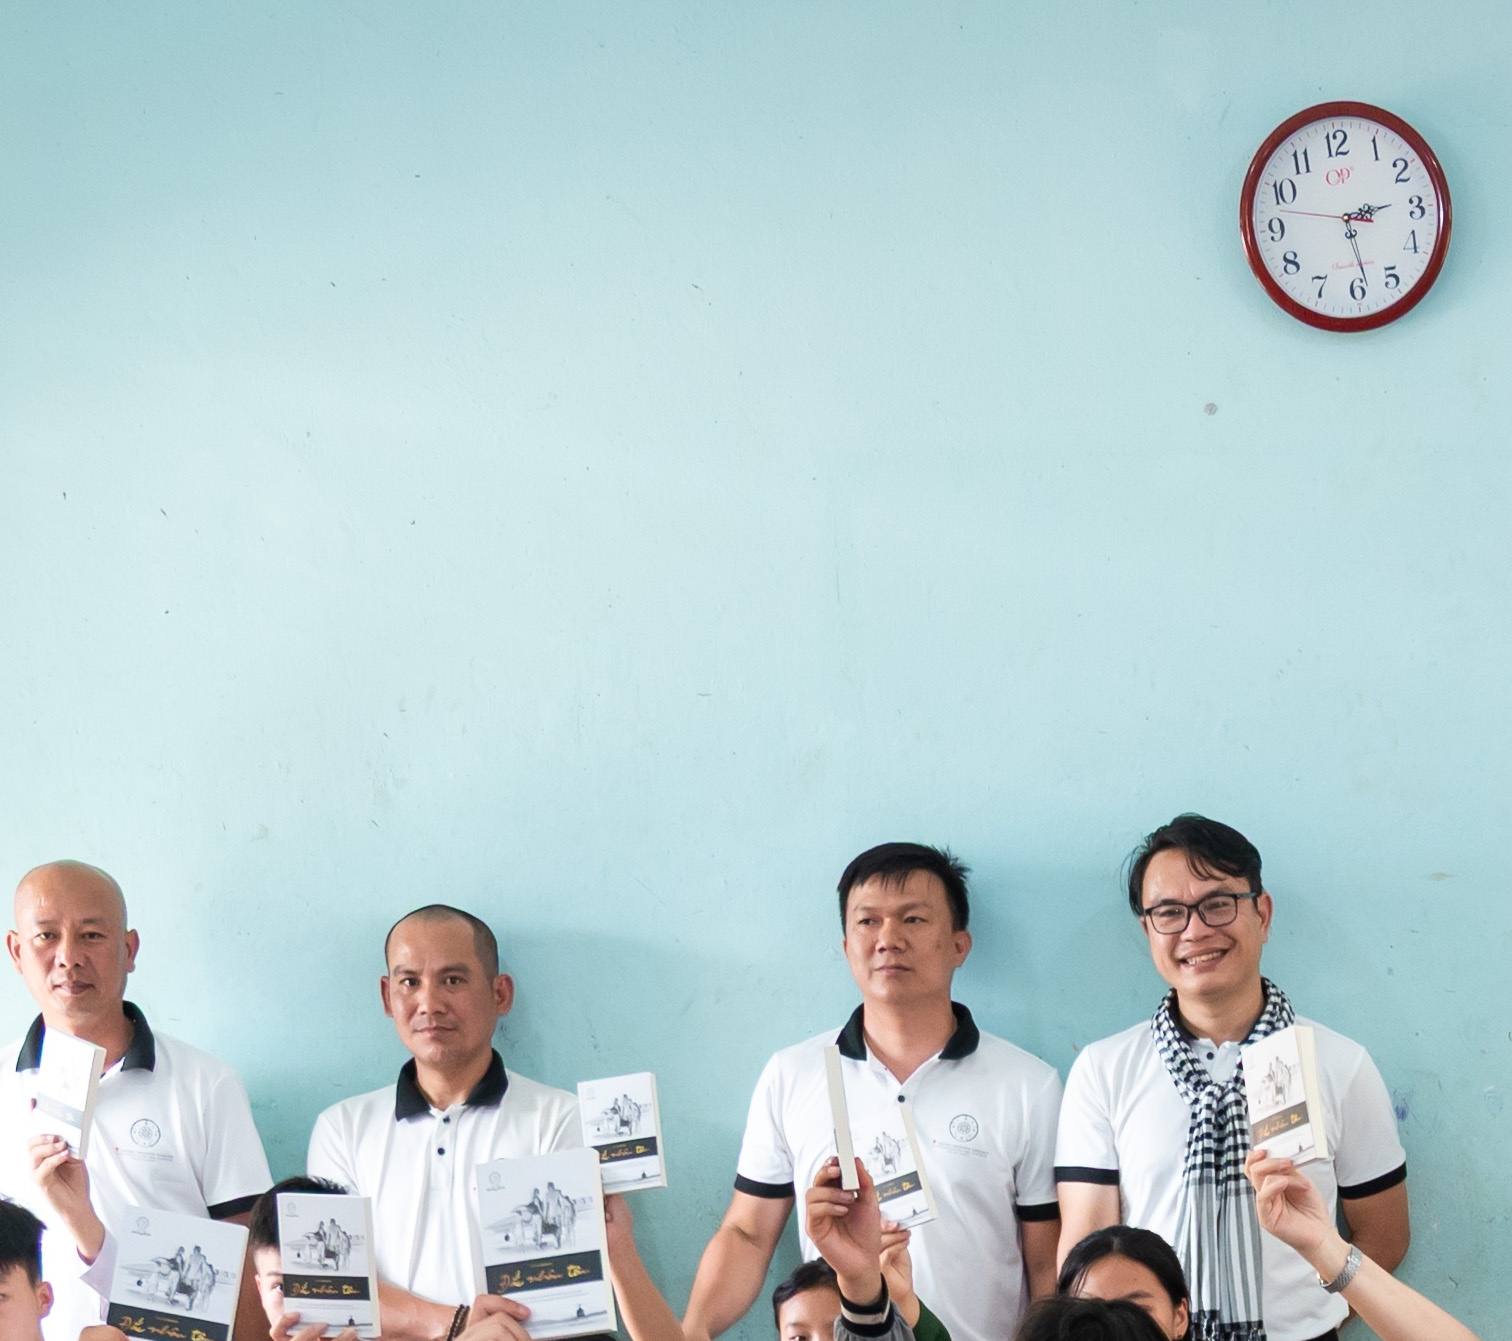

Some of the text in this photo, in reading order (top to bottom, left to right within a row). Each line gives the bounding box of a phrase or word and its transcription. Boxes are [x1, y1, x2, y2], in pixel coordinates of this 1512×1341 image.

[1325, 129, 1350, 158] 12
[1371, 135, 1380, 161] 1
[1292, 147, 1312, 175] 11
[1392, 158, 1411, 184] 2
[1273, 178, 1298, 206] 10
[1408, 195, 1426, 220] 3
[1268, 217, 1286, 243] 9
[1403, 229, 1420, 254] 4
[1282, 251, 1301, 275] 8
[1311, 274, 1328, 299] 7
[1349, 278, 1367, 301] 6
[1384, 265, 1401, 289] 5
